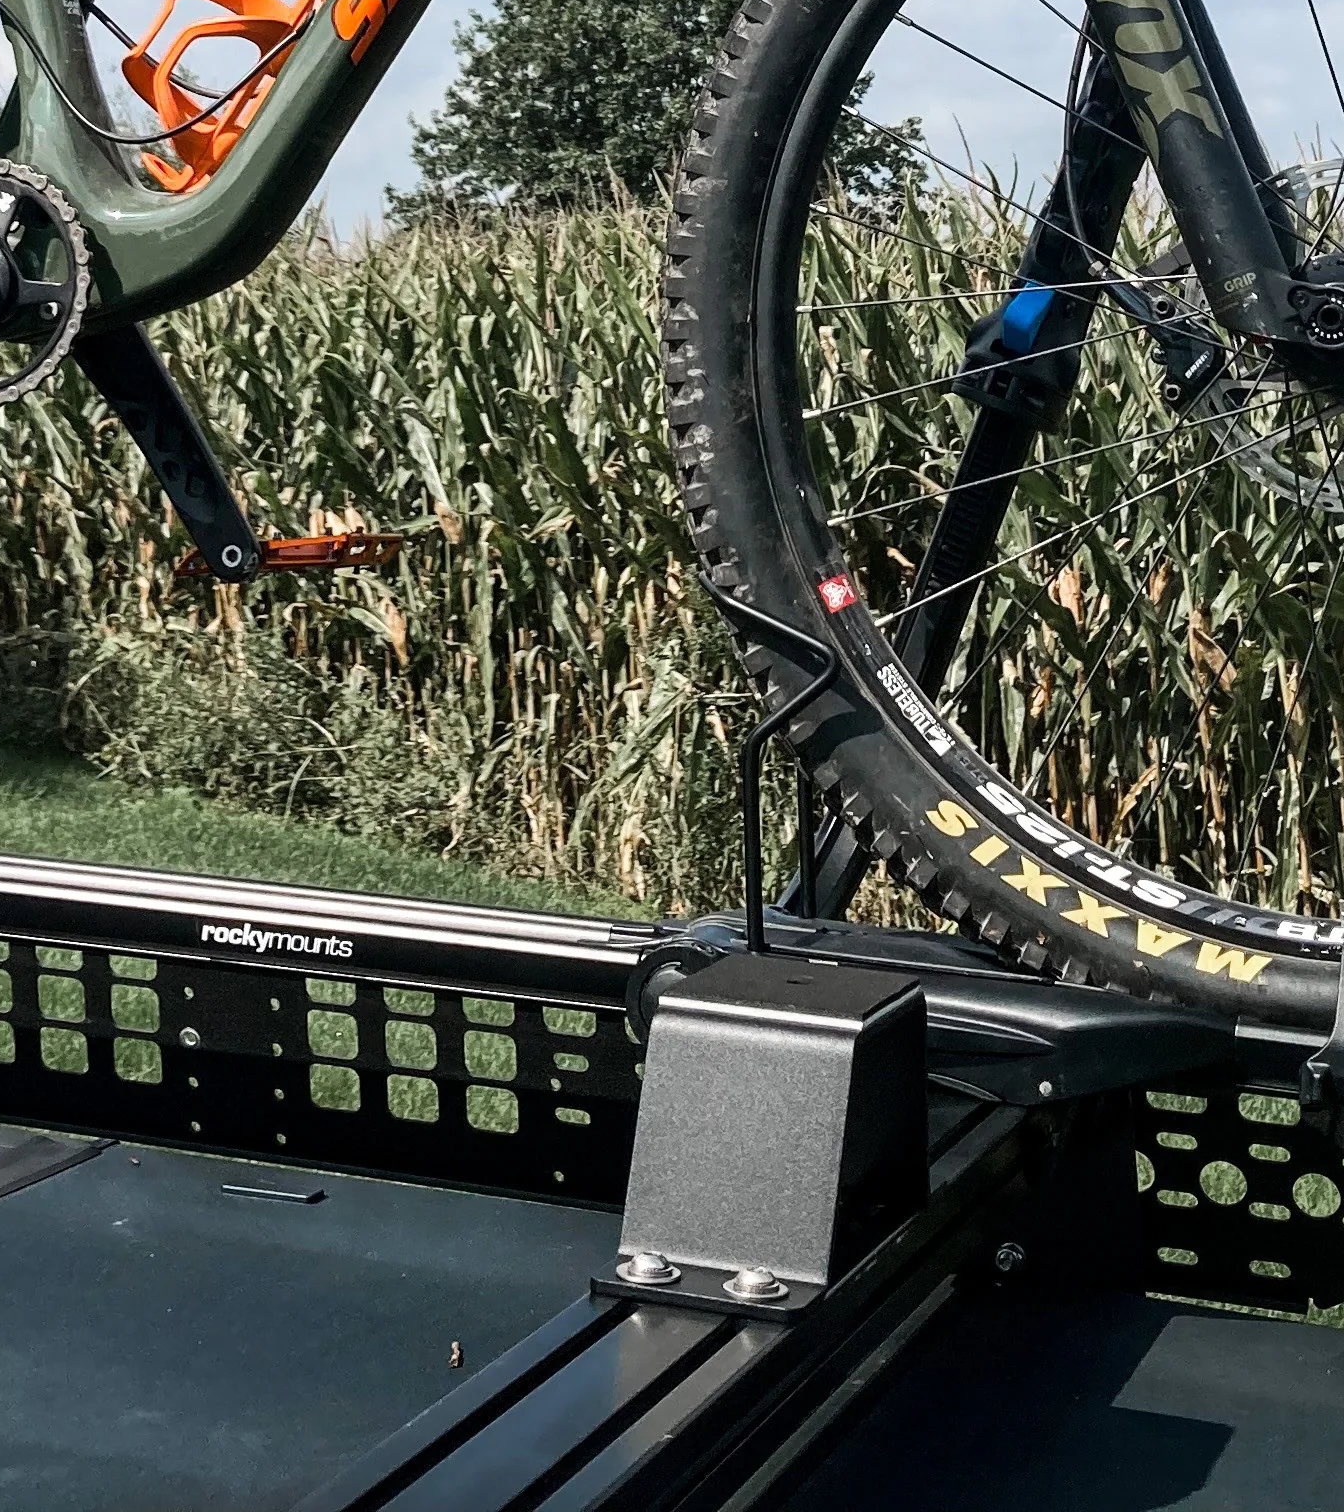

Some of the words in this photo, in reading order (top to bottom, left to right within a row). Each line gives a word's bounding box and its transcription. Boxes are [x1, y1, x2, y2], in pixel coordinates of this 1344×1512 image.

[876, 665, 934, 737] TUBELESS
[925, 800, 1273, 984] MAXXIS
[201, 923, 354, 958] rockymounts
